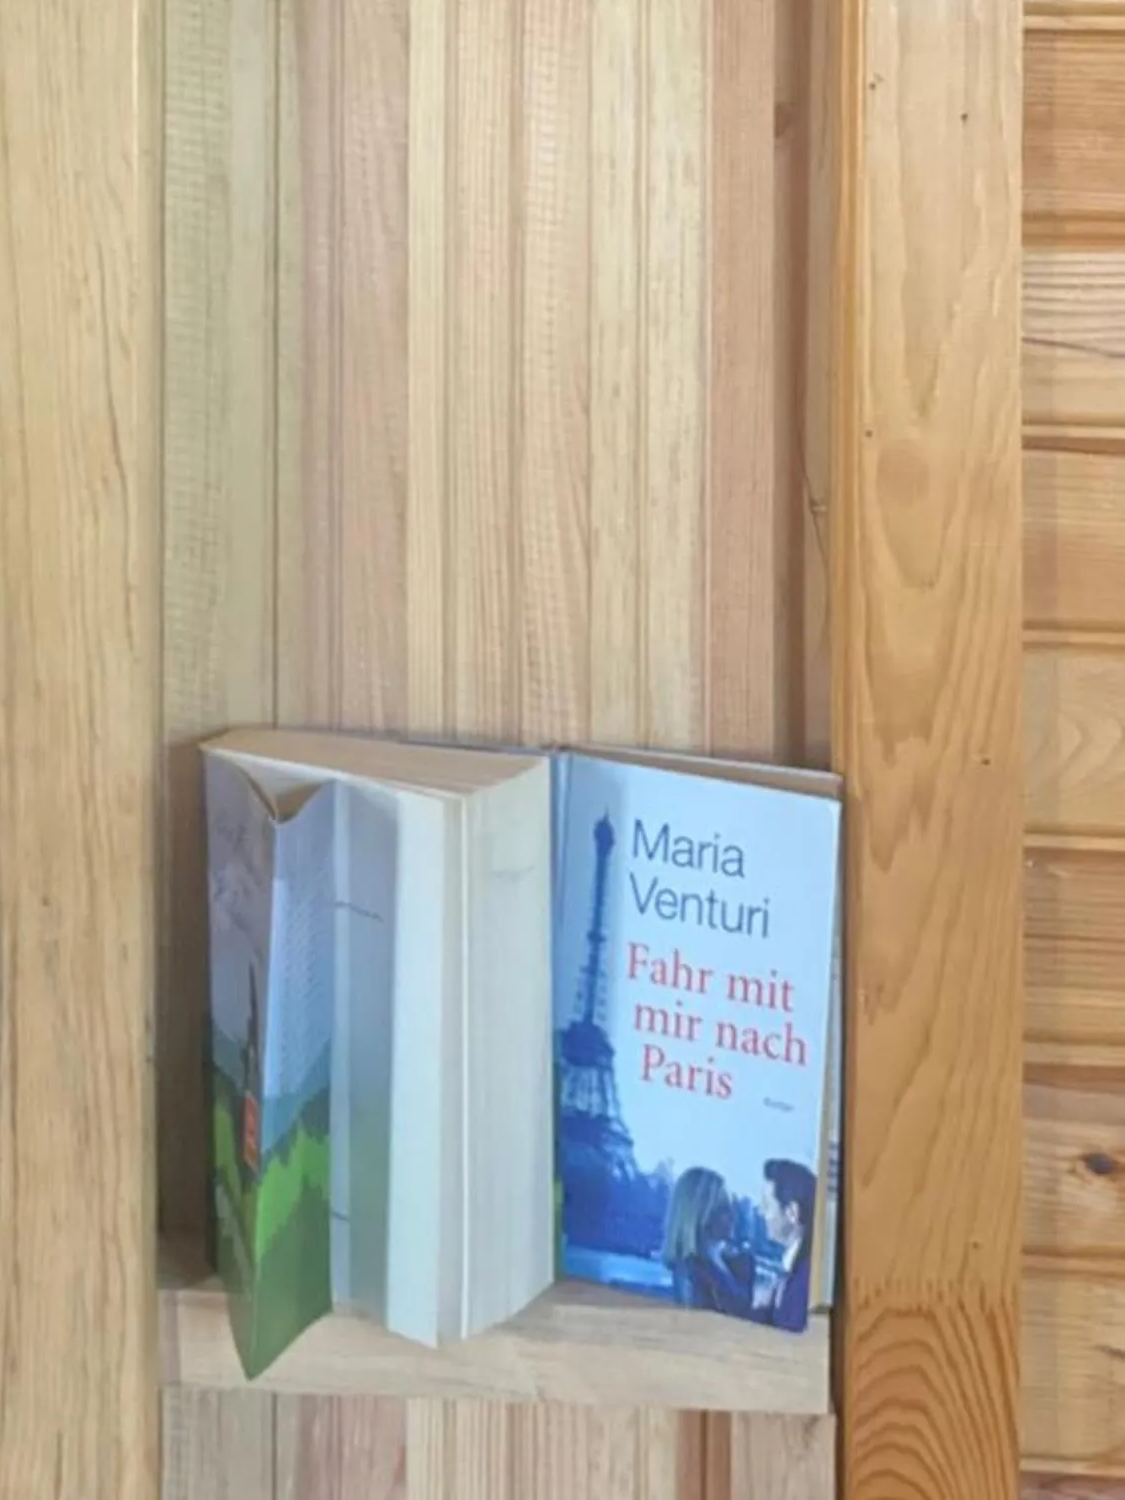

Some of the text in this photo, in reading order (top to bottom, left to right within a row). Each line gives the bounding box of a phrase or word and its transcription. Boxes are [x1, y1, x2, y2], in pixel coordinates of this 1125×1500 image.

[632, 818, 745, 878] Maria
[629, 871, 771, 939] Venturi
[628, 940, 795, 1013] Fahr mit
[633, 1000, 808, 1067] mir nach
[640, 1043, 733, 1101] Paris
